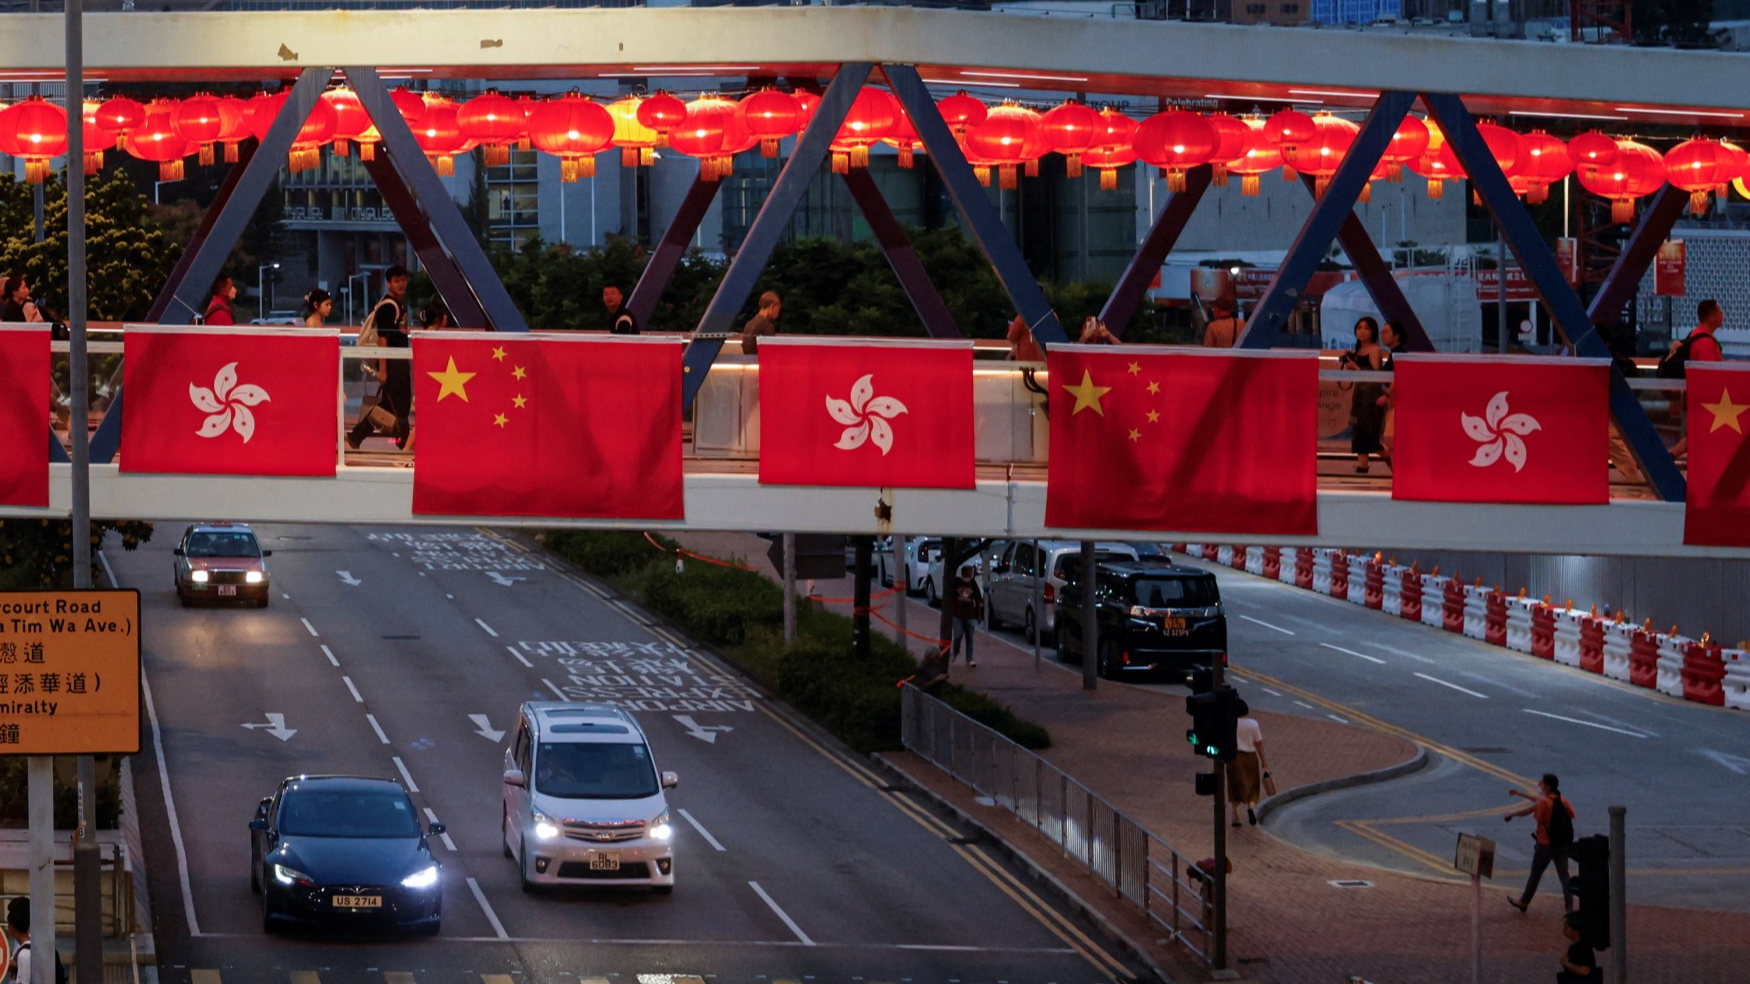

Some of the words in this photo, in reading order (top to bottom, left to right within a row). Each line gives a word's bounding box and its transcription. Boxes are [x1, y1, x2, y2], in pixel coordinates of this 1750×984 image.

[56, 599, 101, 614] Road
[11, 618, 43, 633] Tim
[49, 618, 76, 633] Wa
[84, 618, 131, 636] Ave.)
[588, 699, 755, 712] AIRPOR
[336, 897, 350, 906] US
[354, 897, 377, 906] 2714
